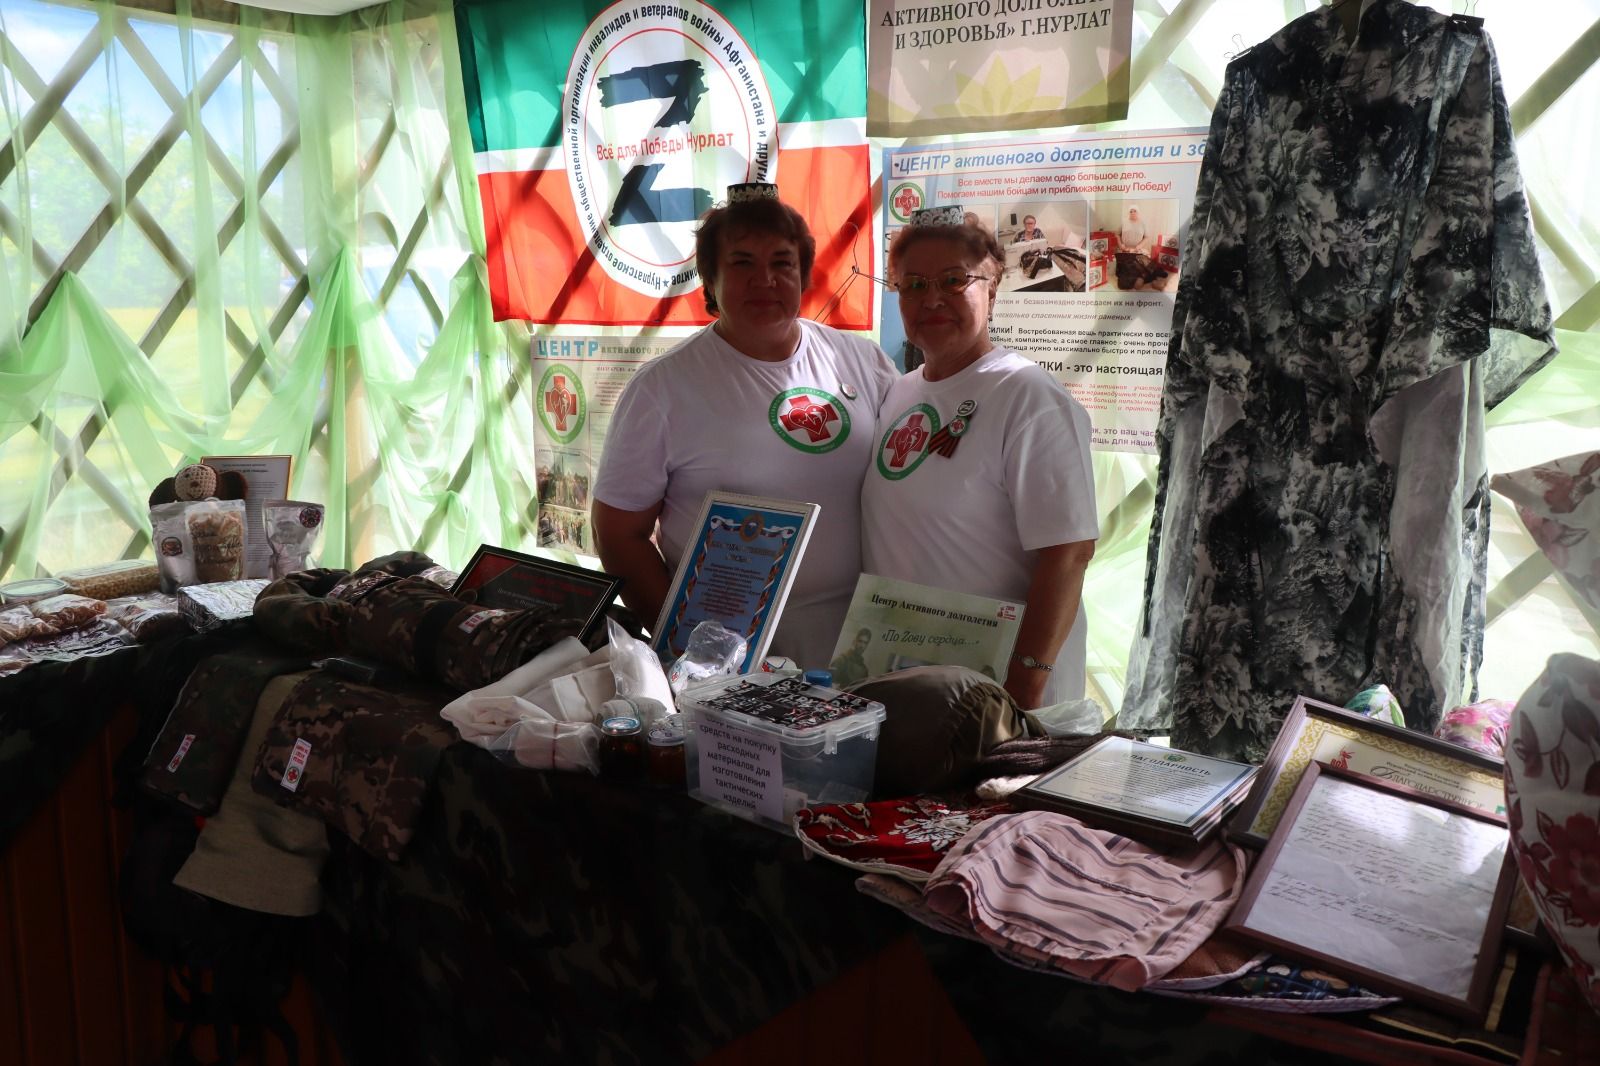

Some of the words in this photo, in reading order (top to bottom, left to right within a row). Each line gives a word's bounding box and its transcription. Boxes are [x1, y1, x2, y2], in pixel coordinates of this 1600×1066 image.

[633, 9, 639, 21] и
[641, 5, 689, 23] ветеранов
[881, 0, 991, 27] АКТИВНОГО
[588, 13, 632, 55] инвалидов
[690, 14, 725, 46] войны
[895, 33, 906, 50] И
[909, 22, 1016, 50] ЗДОРОВЬЯ»
[1020, 8, 1111, 37] Г.НУРЛАТ
[571, 53, 592, 126] организации
[723, 41, 766, 126] Афганистана
[596, 143, 614, 161] Всё
[617, 145, 638, 161] для
[640, 136, 684, 156] Победы
[686, 131, 735, 152] Нурлат
[568, 128, 597, 213] общественной
[899, 154, 951, 175] ЦЕНТР
[954, 151, 1045, 170] активного
[1050, 144, 1164, 163] долголетия
[1170, 143, 1181, 157] и
[937, 189, 976, 200] Помогаем
[976, 188, 1005, 198] нашим
[1006, 186, 1039, 197] бойцам
[1040, 187, 1047, 195] и
[1048, 184, 1105, 196] приближаем
[1105, 183, 1131, 195] нашу
[1132, 180, 1172, 194] Победу!
[958, 178, 973, 187] Все
[974, 177, 1002, 187] вместе
[1003, 177, 1018, 185] мы
[1019, 175, 1053, 185] делаем
[1054, 174, 1076, 184] одно
[1077, 171, 1119, 181] большое
[1119, 170, 1147, 181] дело.
[587, 213, 615, 263] отделение
[612, 261, 662, 291] Нурлатское
[1136, 299, 1164, 308] фронт.
[1018, 327, 1077, 337] Востребованная
[1097, 331, 1143, 339] практически
[537, 339, 600, 358] ЦЕНТР
[1053, 346, 1101, 354] максимально
[1101, 347, 1128, 355] быстро
[1136, 348, 1151, 356] при
[1073, 364, 1093, 374] это
[1096, 363, 1163, 376] настоящая
[1103, 428, 1118, 436] это
[1120, 429, 1138, 437] ваш
[1111, 439, 1129, 447] для
[871, 593, 898, 609] Центр
[898, 600, 946, 618] Активного
[946, 610, 999, 628] долголетия
[699, 724, 731, 740] средств
[732, 735, 742, 744] на
[744, 738, 777, 757] покупку
[717, 741, 760, 762] расходных
[707, 751, 755, 773] материалов
[755, 764, 771, 780] для
[712, 764, 766, 789] изготовления
[715, 777, 764, 801] тактических
[723, 793, 757, 810] изделий
